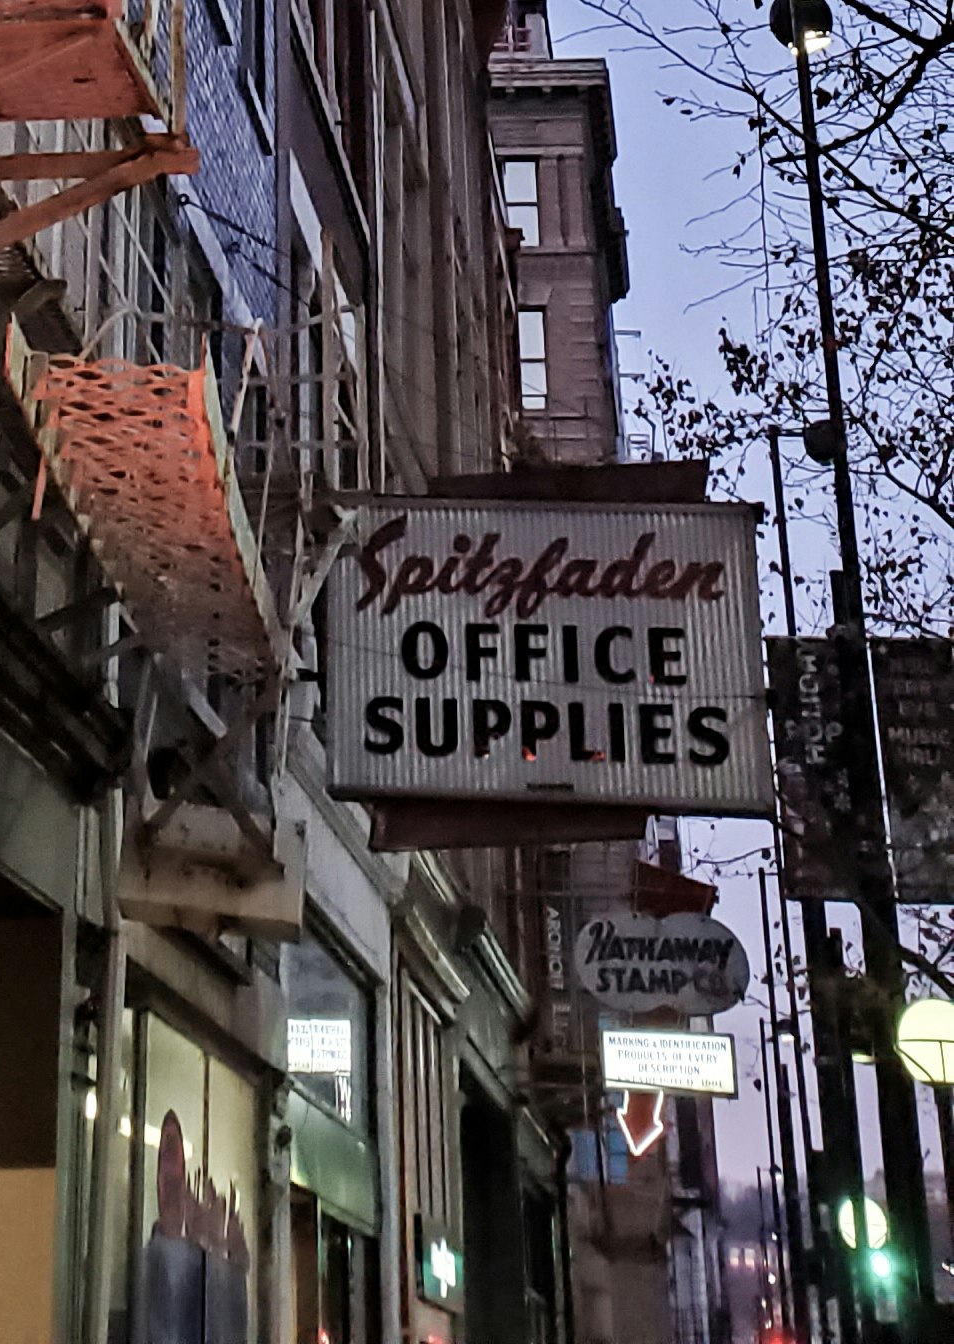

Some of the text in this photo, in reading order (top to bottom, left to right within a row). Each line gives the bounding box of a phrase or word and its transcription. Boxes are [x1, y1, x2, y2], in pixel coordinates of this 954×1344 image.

[355, 514, 724, 618] Spitzfaden
[401, 620, 688, 686] OFFICE
[363, 696, 731, 767] SUPPLIES
[596, 967, 689, 995] STAMP
[608, 1036, 649, 1048] MARKING
[659, 1038, 727, 1051] IDENTIFICATION
[618, 1049, 718, 1064] PRODUCTS OF EVERY
[638, 1063, 700, 1075] DESCRIPTION
